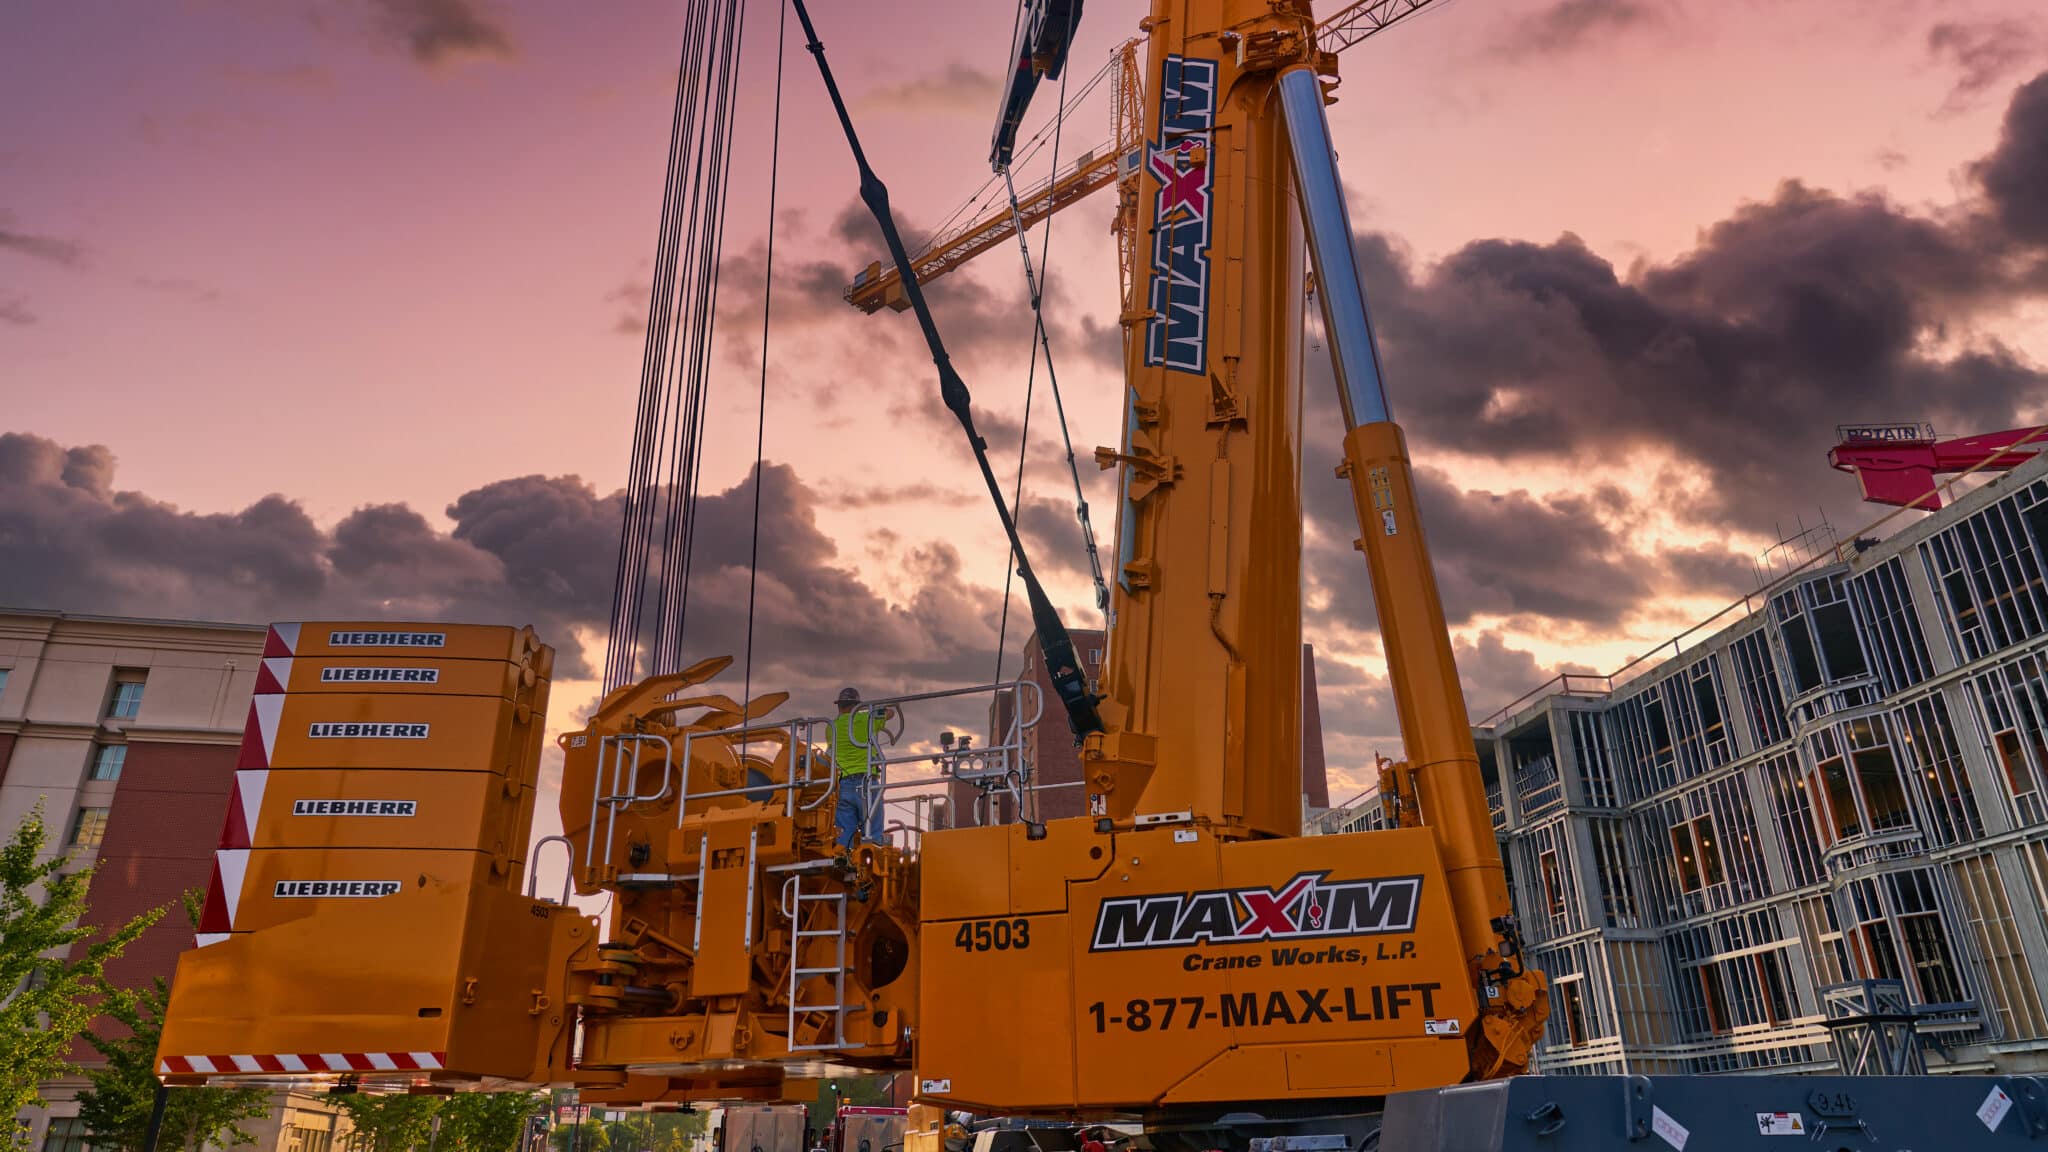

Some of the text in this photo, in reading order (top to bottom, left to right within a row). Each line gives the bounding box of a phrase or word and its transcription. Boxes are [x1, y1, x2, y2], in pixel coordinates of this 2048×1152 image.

[1147, 54, 1216, 374] MAXIM
[331, 633, 443, 646] LIEBHERR
[322, 669, 437, 681] LIEBHERR
[310, 724, 428, 737] LIEBHERR
[295, 801, 414, 814] LIEBHERR
[276, 882, 398, 896] LIEBHERR
[1091, 872, 1422, 951] MAXIM
[955, 919, 1030, 952] 4503
[1183, 941, 1418, 971] Crane Works, L.P.
[1088, 982, 1441, 1033] 1-877-MAX-LIFT
